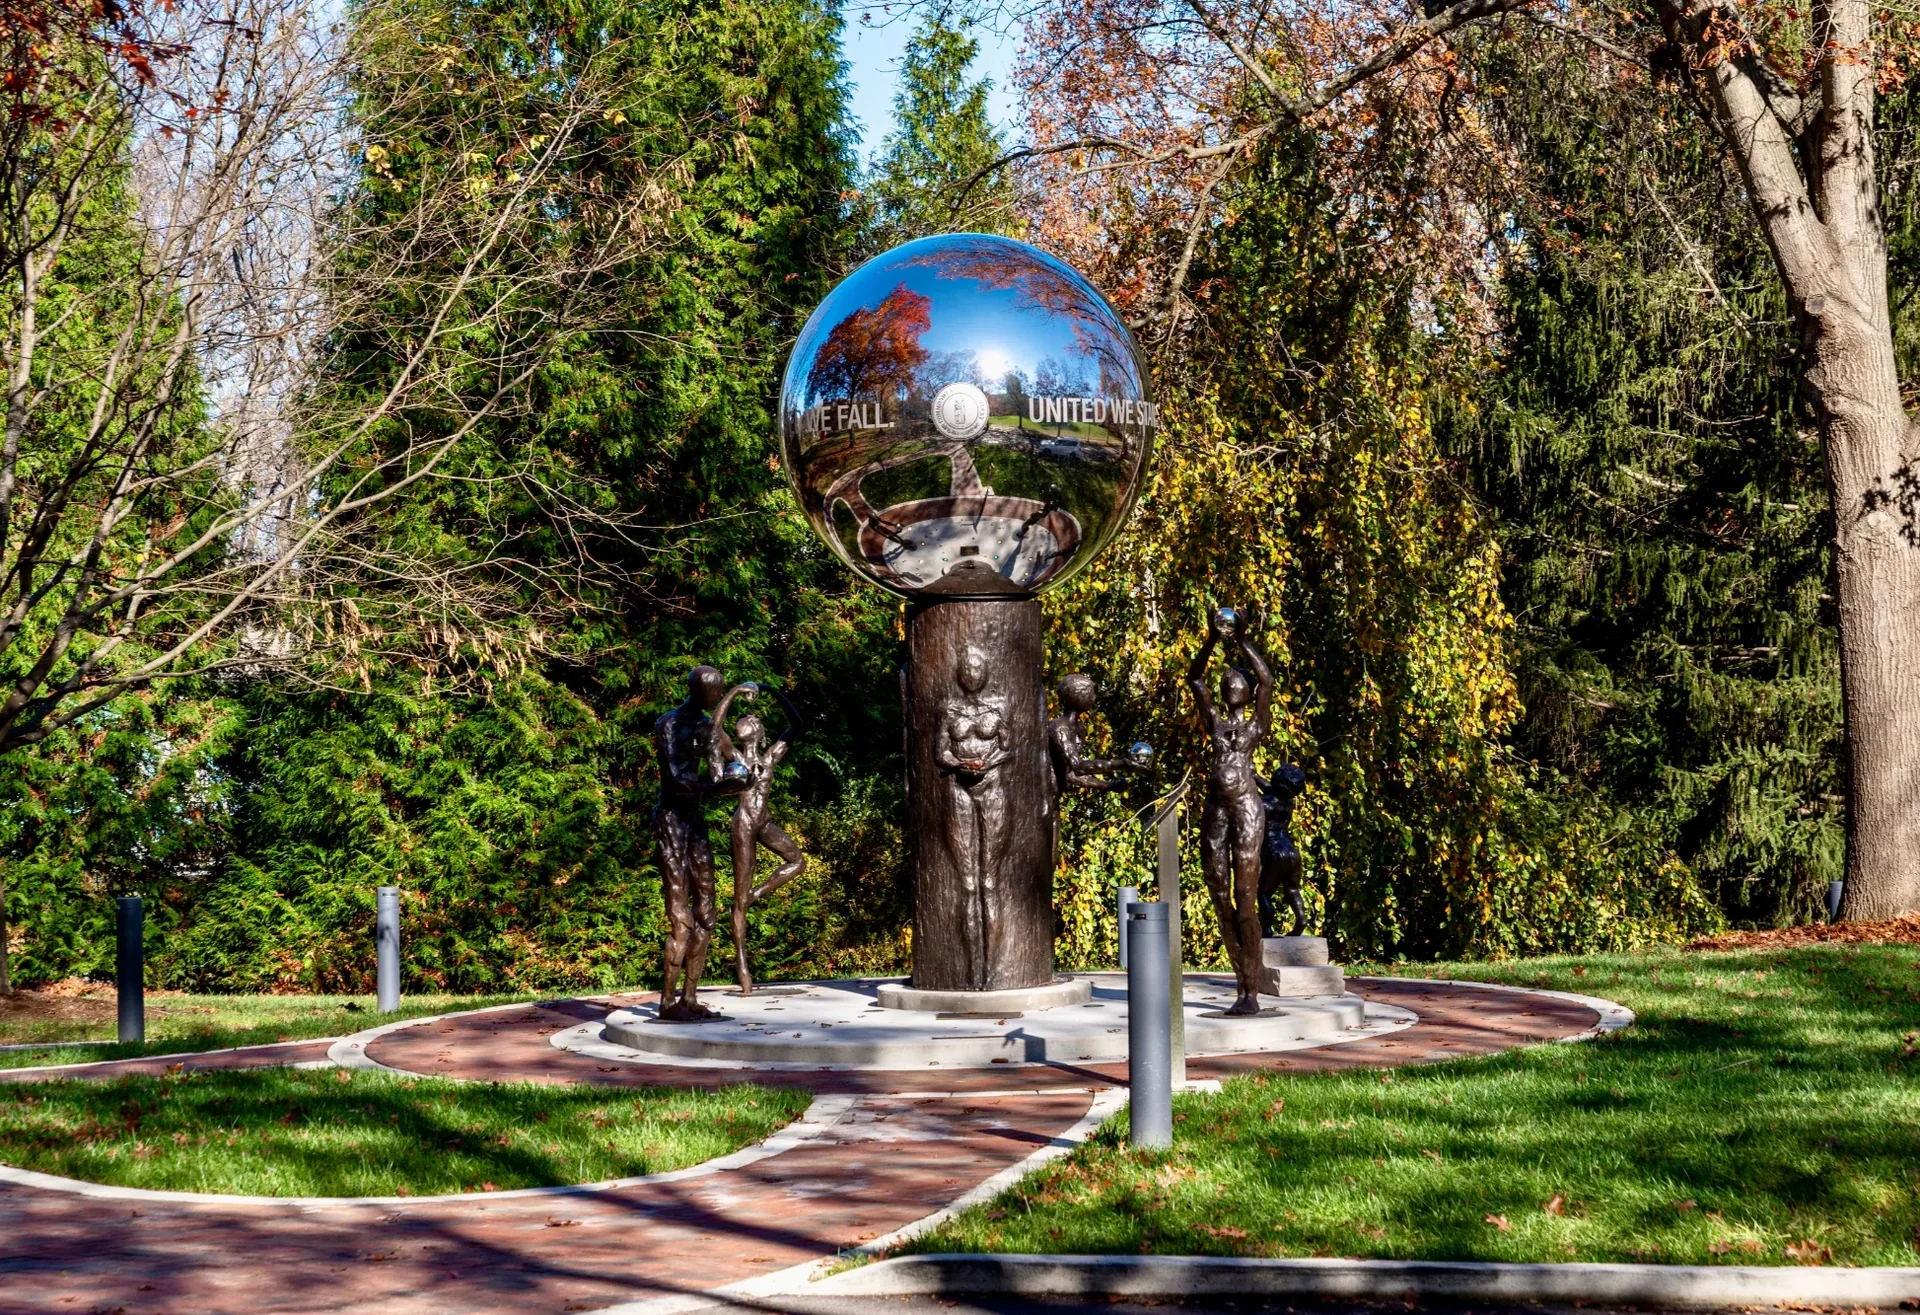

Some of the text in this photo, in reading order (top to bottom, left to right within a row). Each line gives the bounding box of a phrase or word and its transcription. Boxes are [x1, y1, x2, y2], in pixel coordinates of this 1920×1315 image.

[806, 405, 832, 432] WE
[837, 403, 895, 430] FALL.
[1028, 397, 1107, 423] UNITED
[1110, 399, 1135, 424] WE
